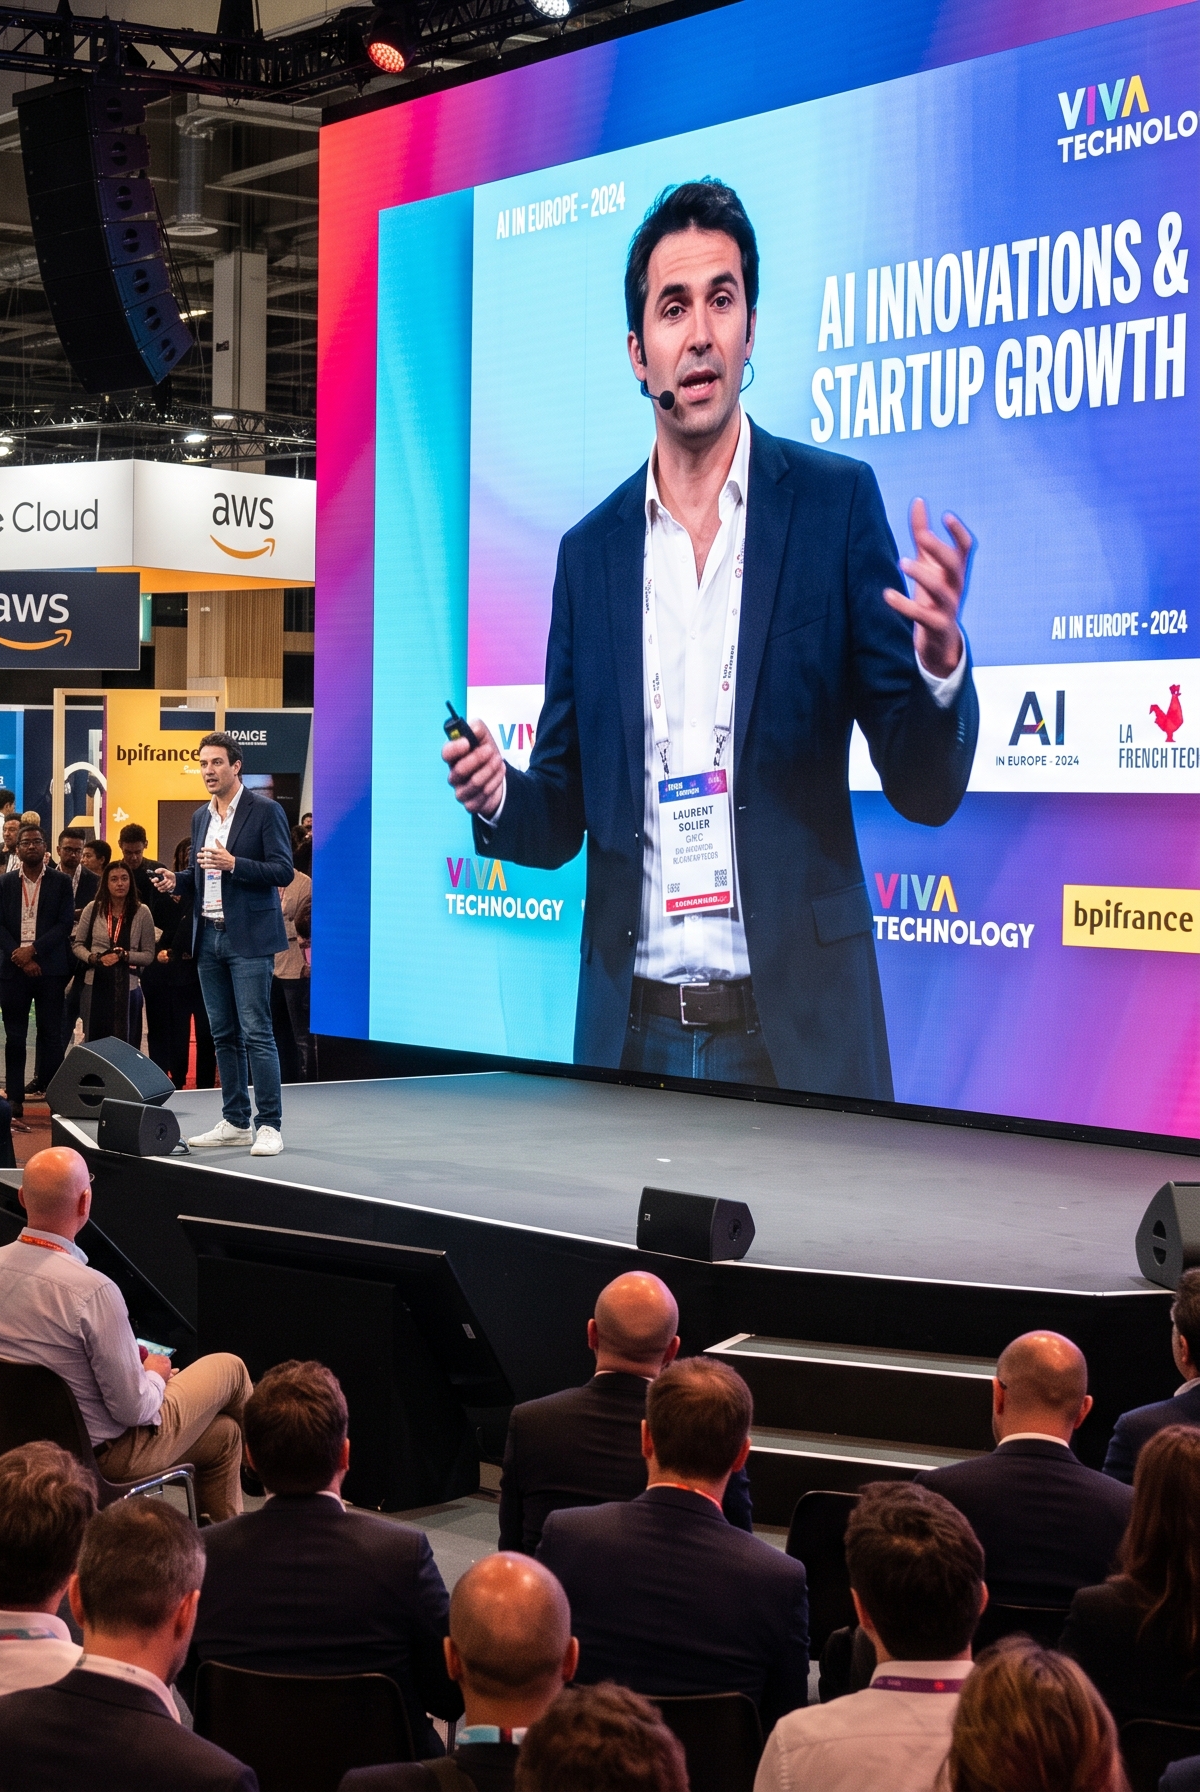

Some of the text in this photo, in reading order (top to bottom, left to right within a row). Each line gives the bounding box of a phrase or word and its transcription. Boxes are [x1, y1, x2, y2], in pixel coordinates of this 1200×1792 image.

[1058, 75, 1150, 130] VIVA
[1057, 110, 1200, 163] TECHNOLO
[496, 209, 509, 240] AI
[512, 205, 526, 236] IN
[528, 192, 578, 232] EUROPE
[591, 181, 626, 217] 2024
[818, 210, 1189, 352] AI INNOVATIONS &
[810, 312, 1187, 444] STARTUP GROWTH
[12, 499, 98, 533] Cloud
[212, 491, 275, 530] aws
[1052, 616, 1066, 640] AI
[1069, 615, 1083, 638] IN
[1086, 612, 1139, 637] EUROPE
[1150, 610, 1188, 635] 2024
[1008, 690, 1065, 746] AI
[1119, 724, 1133, 743] LA
[116, 743, 200, 765] bpifrance
[996, 756, 1005, 766] IN
[1008, 756, 1047, 766] EUROPE
[1055, 755, 1079, 766] 2024
[1119, 747, 1168, 768] FRENCH
[673, 805, 714, 820] LAURENT
[678, 819, 710, 832] SOLIER
[446, 857, 508, 891] VIVA
[445, 893, 564, 921] TECHNOLOGY
[874, 873, 958, 913] VIVA
[873, 915, 1035, 949] TECHNOLOGY
[1074, 899, 1194, 935] bpifrance
